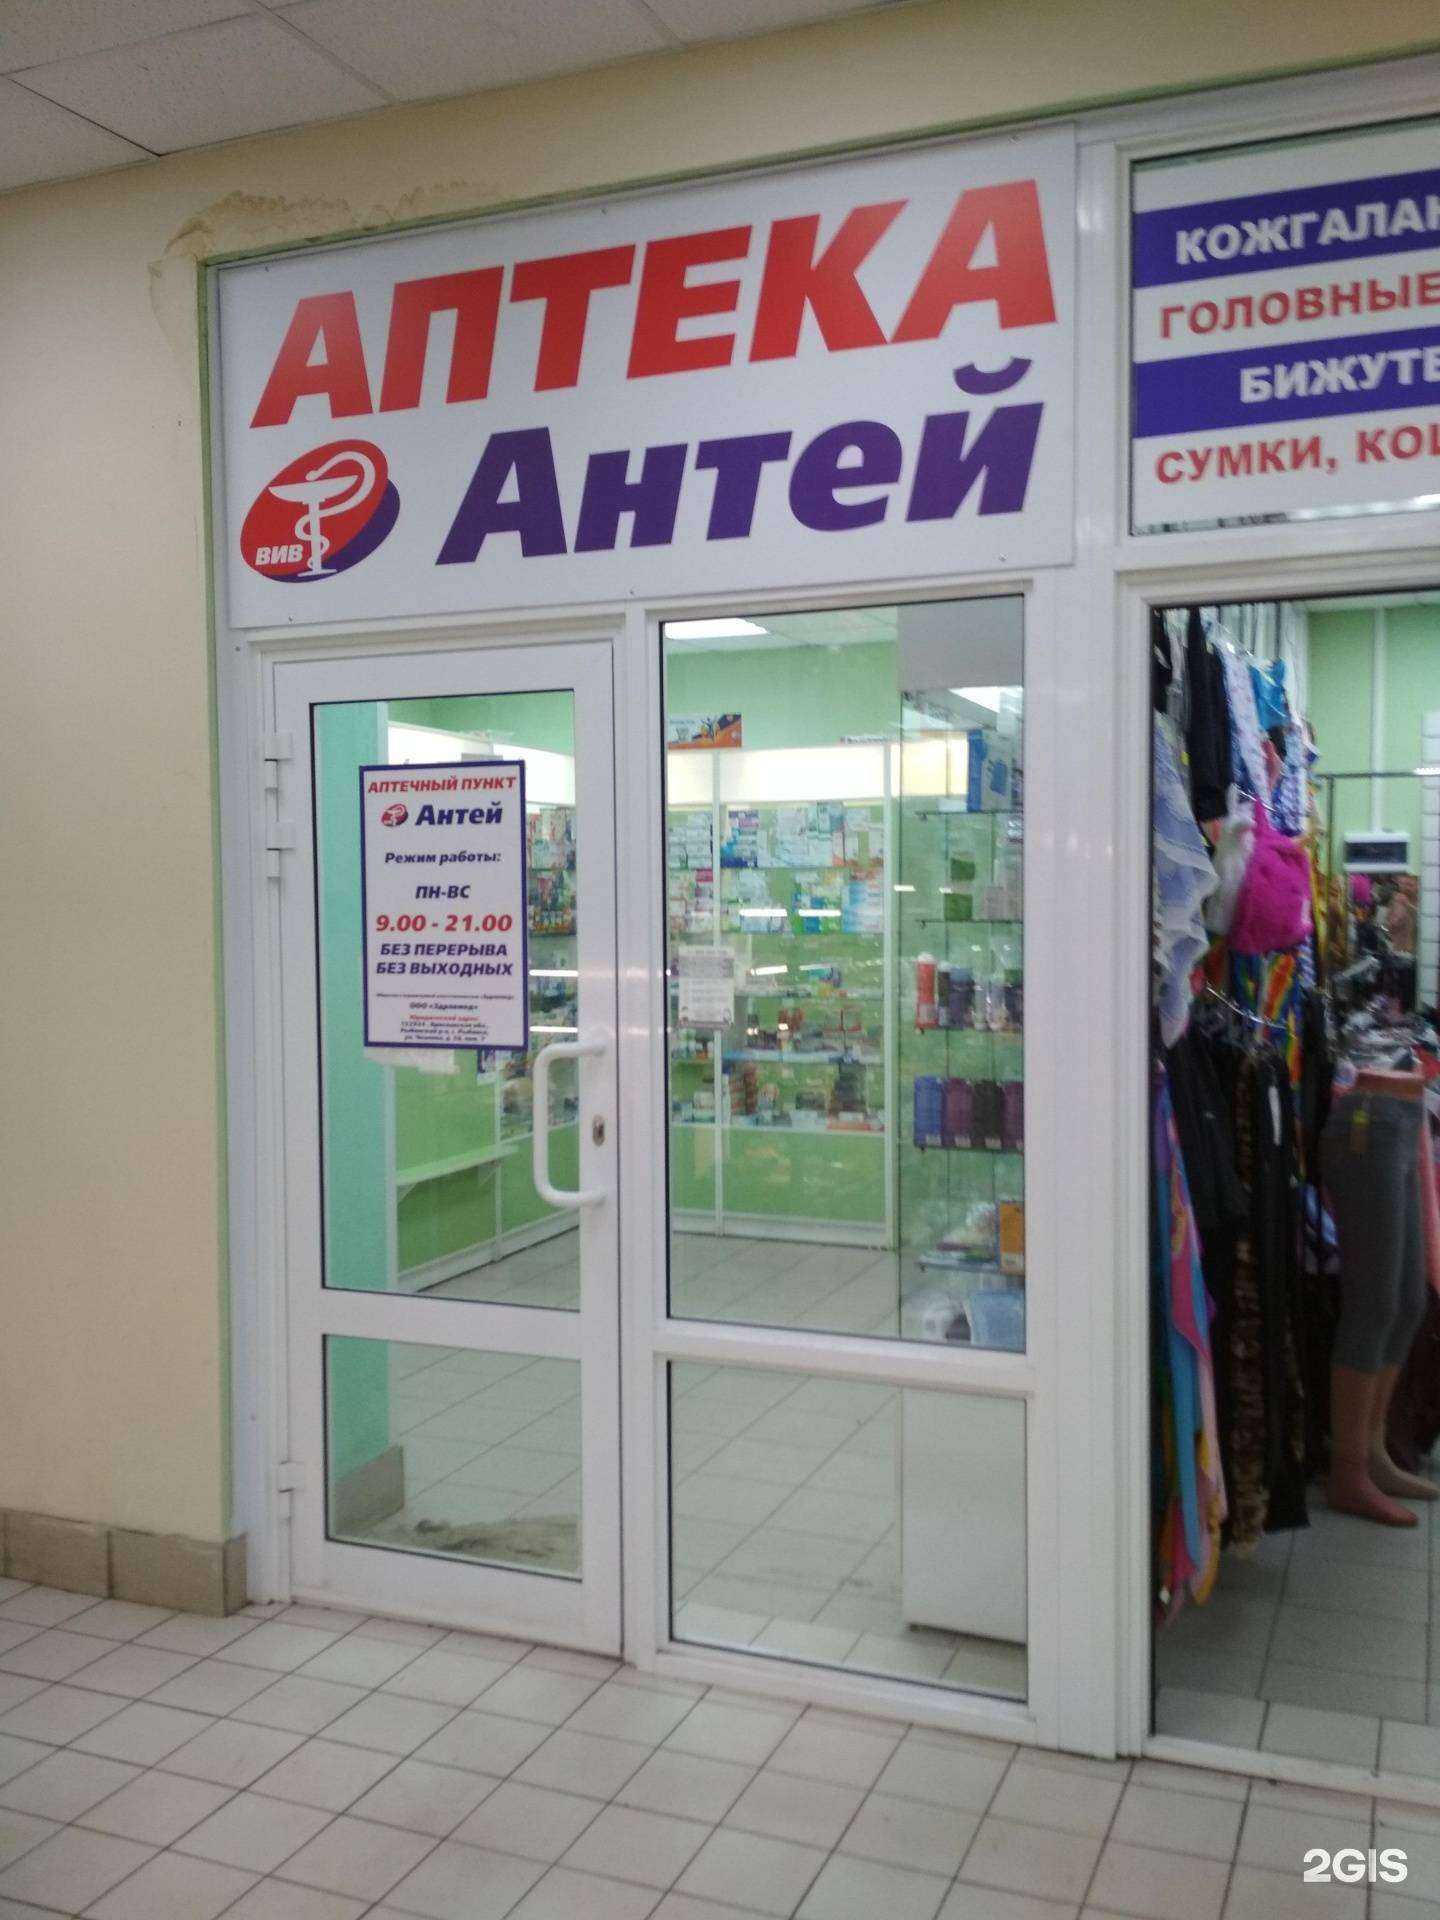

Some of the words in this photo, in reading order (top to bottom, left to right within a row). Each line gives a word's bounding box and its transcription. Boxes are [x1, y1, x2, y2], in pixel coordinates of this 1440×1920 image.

[249, 178, 1058, 429] АПТЕКА
[1159, 271, 1440, 339] ГОЛОВНЫЕ
[1240, 346, 1440, 403] БИЖУТЕ
[434, 357, 1044, 566] Антей
[1155, 434, 1338, 485] СУМКИ,
[1356, 422, 1440, 463] КО
[255, 544, 303, 566] ВИВ
[368, 776, 458, 793] АПТЕЧНЫЙ
[461, 776, 516, 790] ПУНКТ
[414, 801, 503, 826] Антей
[385, 852, 437, 864] Режим
[439, 851, 502, 866] работы:
[415, 885, 471, 899] ПН-ВС
[376, 914, 426, 932] 9.00
[445, 914, 513, 932] 21.00
[380, 943, 411, 956] БЕЗ
[414, 943, 508, 957] ПЕРЕРЫВА
[376, 962, 407, 974] БЕЗ
[410, 962, 514, 977] ВЫХОДНЫХ
